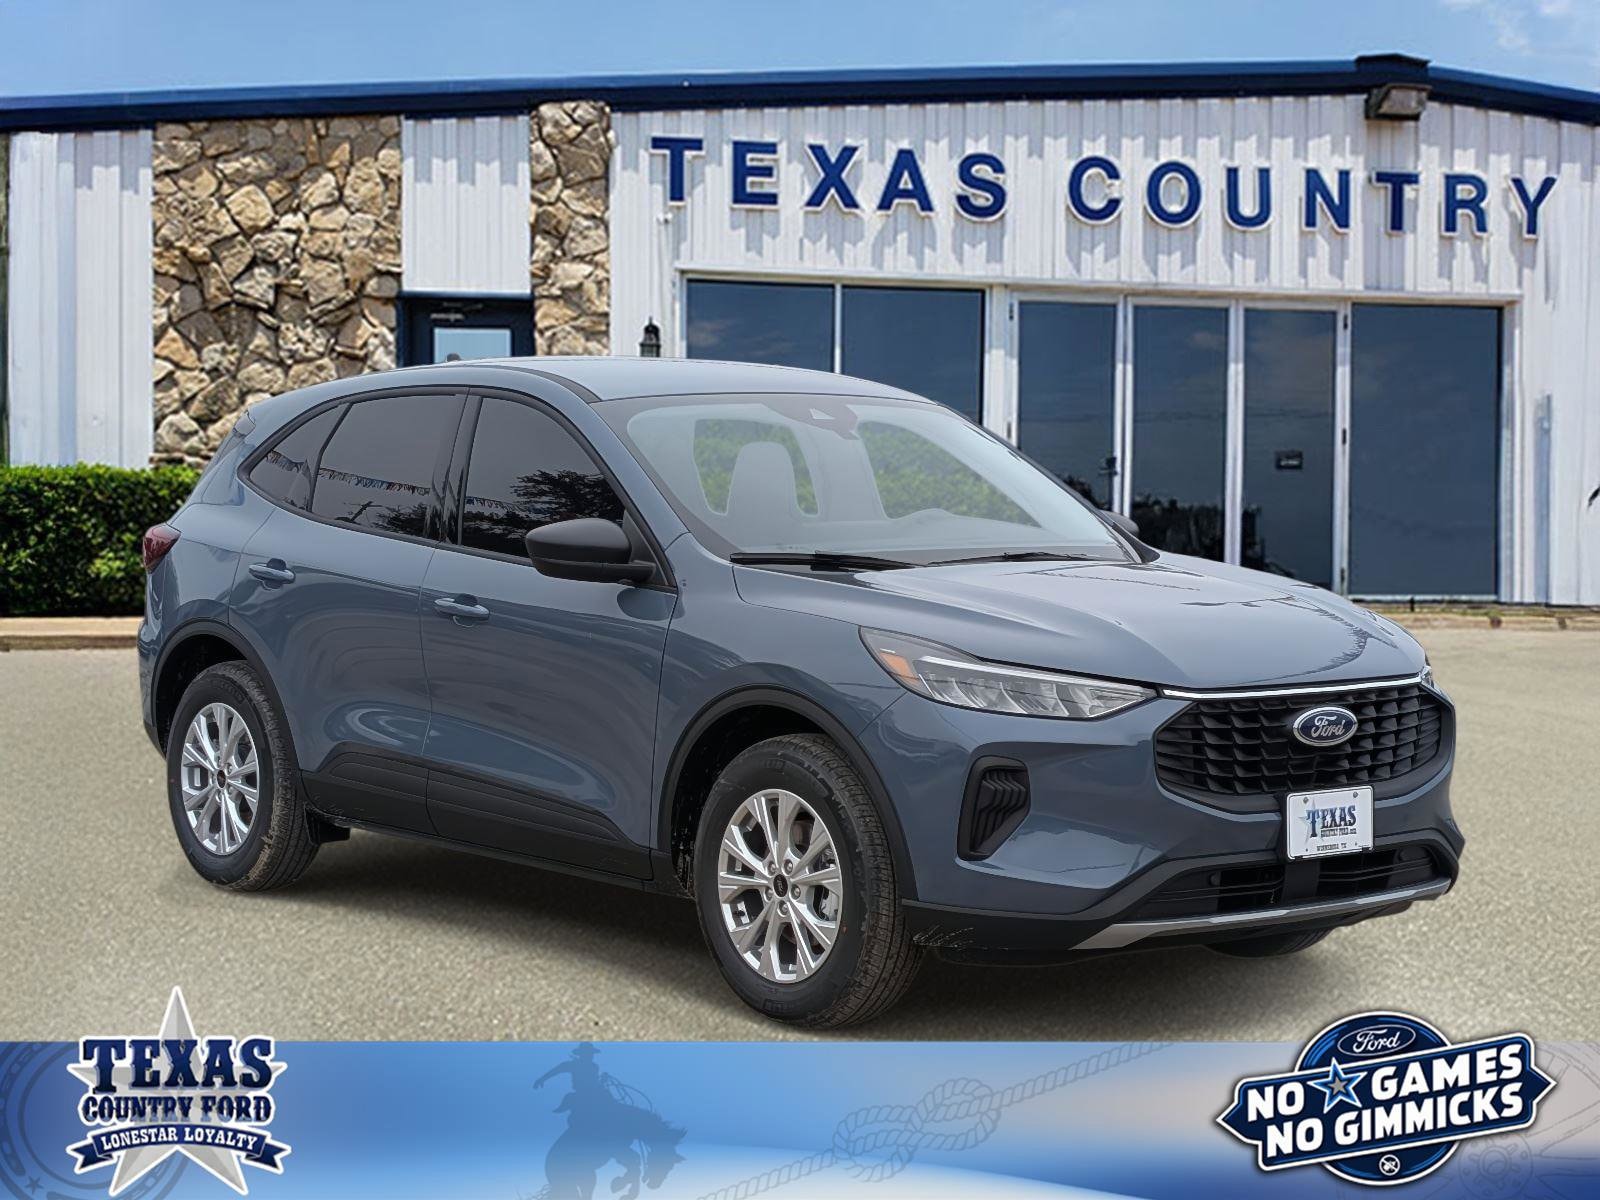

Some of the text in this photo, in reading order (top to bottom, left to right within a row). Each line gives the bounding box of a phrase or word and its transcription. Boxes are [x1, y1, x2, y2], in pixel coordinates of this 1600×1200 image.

[650, 136, 1557, 239] TEXAS COUNTRY
[1311, 715, 1346, 738] Ford
[1305, 805, 1357, 838] TEXAS
